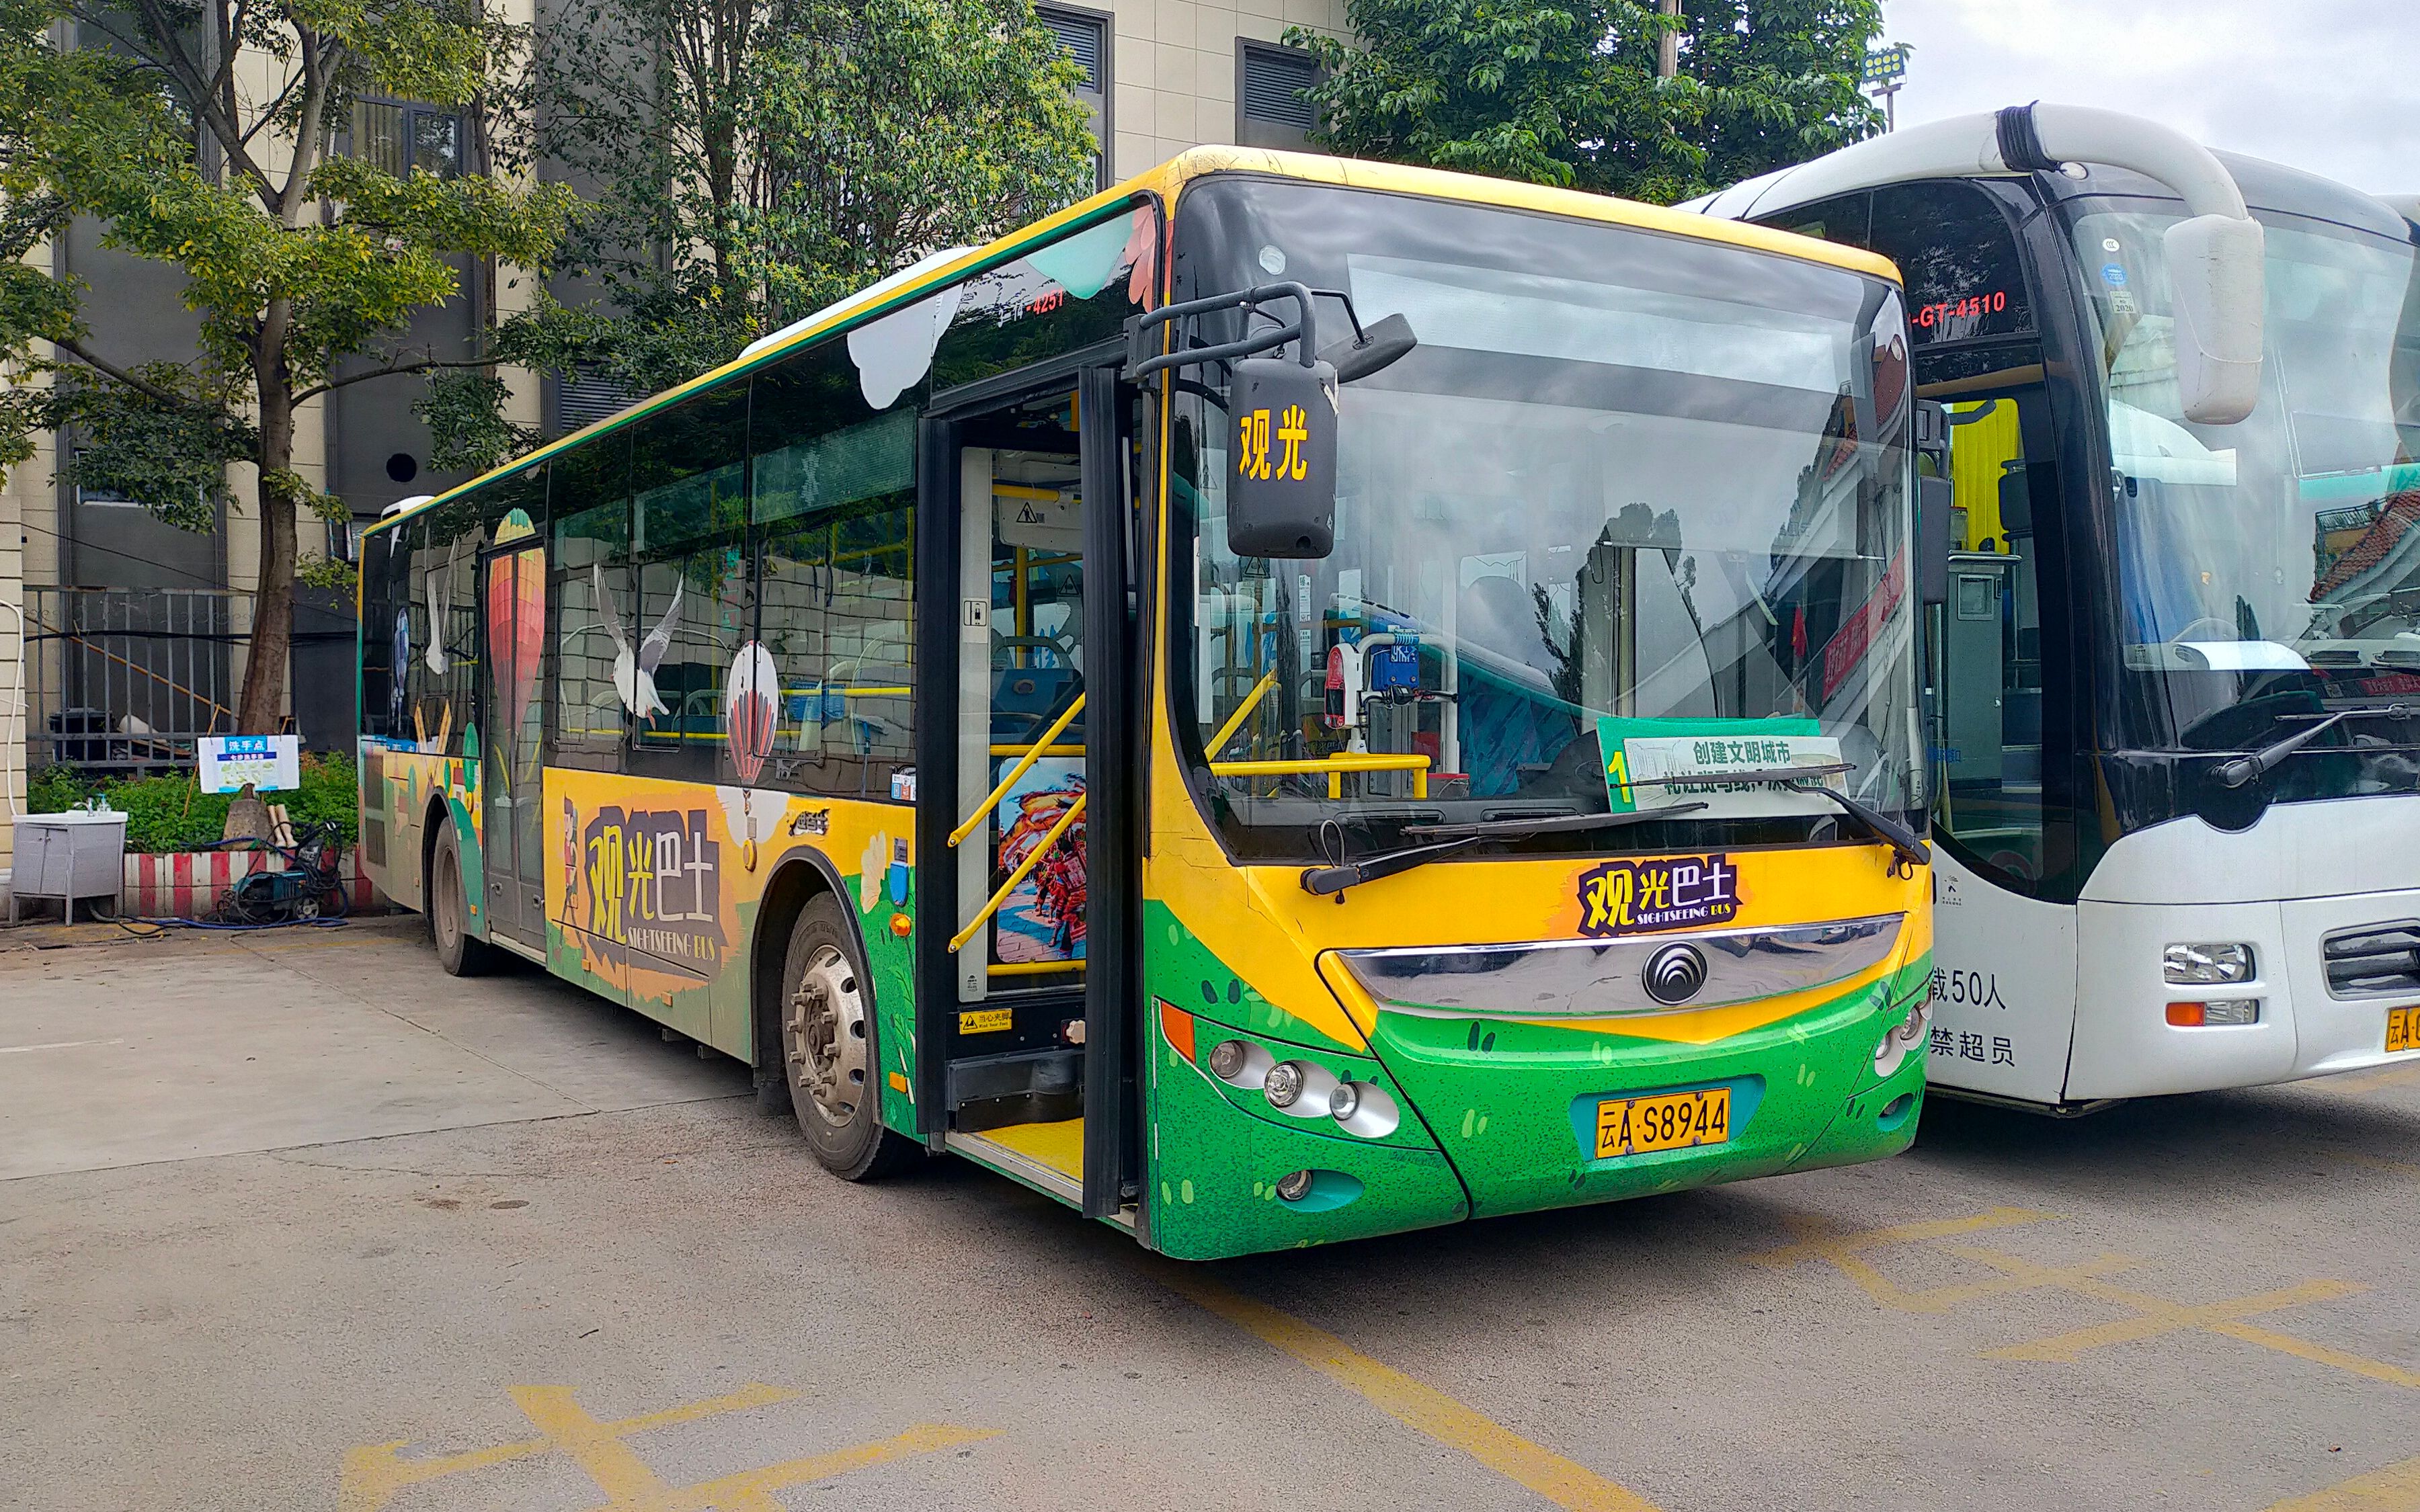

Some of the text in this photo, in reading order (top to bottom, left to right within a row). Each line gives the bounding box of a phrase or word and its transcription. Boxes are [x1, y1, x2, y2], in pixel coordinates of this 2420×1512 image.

[1908, 291, 2006, 327] -GT-4510
[2115, 304, 2134, 312] 2020
[1239, 405, 1307, 480] 观光
[229, 740, 266, 751] 洗手点
[1693, 741, 1791, 765] 创建文明城市
[1608, 751, 1632, 803] 1
[589, 825, 713, 945] 观光巴士
[1586, 862, 1732, 930] 观光巴士
[1637, 902, 1732, 925] SIGHTSEEING BUS
[627, 926, 715, 961] SIGHTSEEING BUS
[1933, 966, 2007, 1010] 载50人
[979, 1013, 1010, 1022] 当心夹脚
[1930, 1025, 2015, 1067] 禁超员
